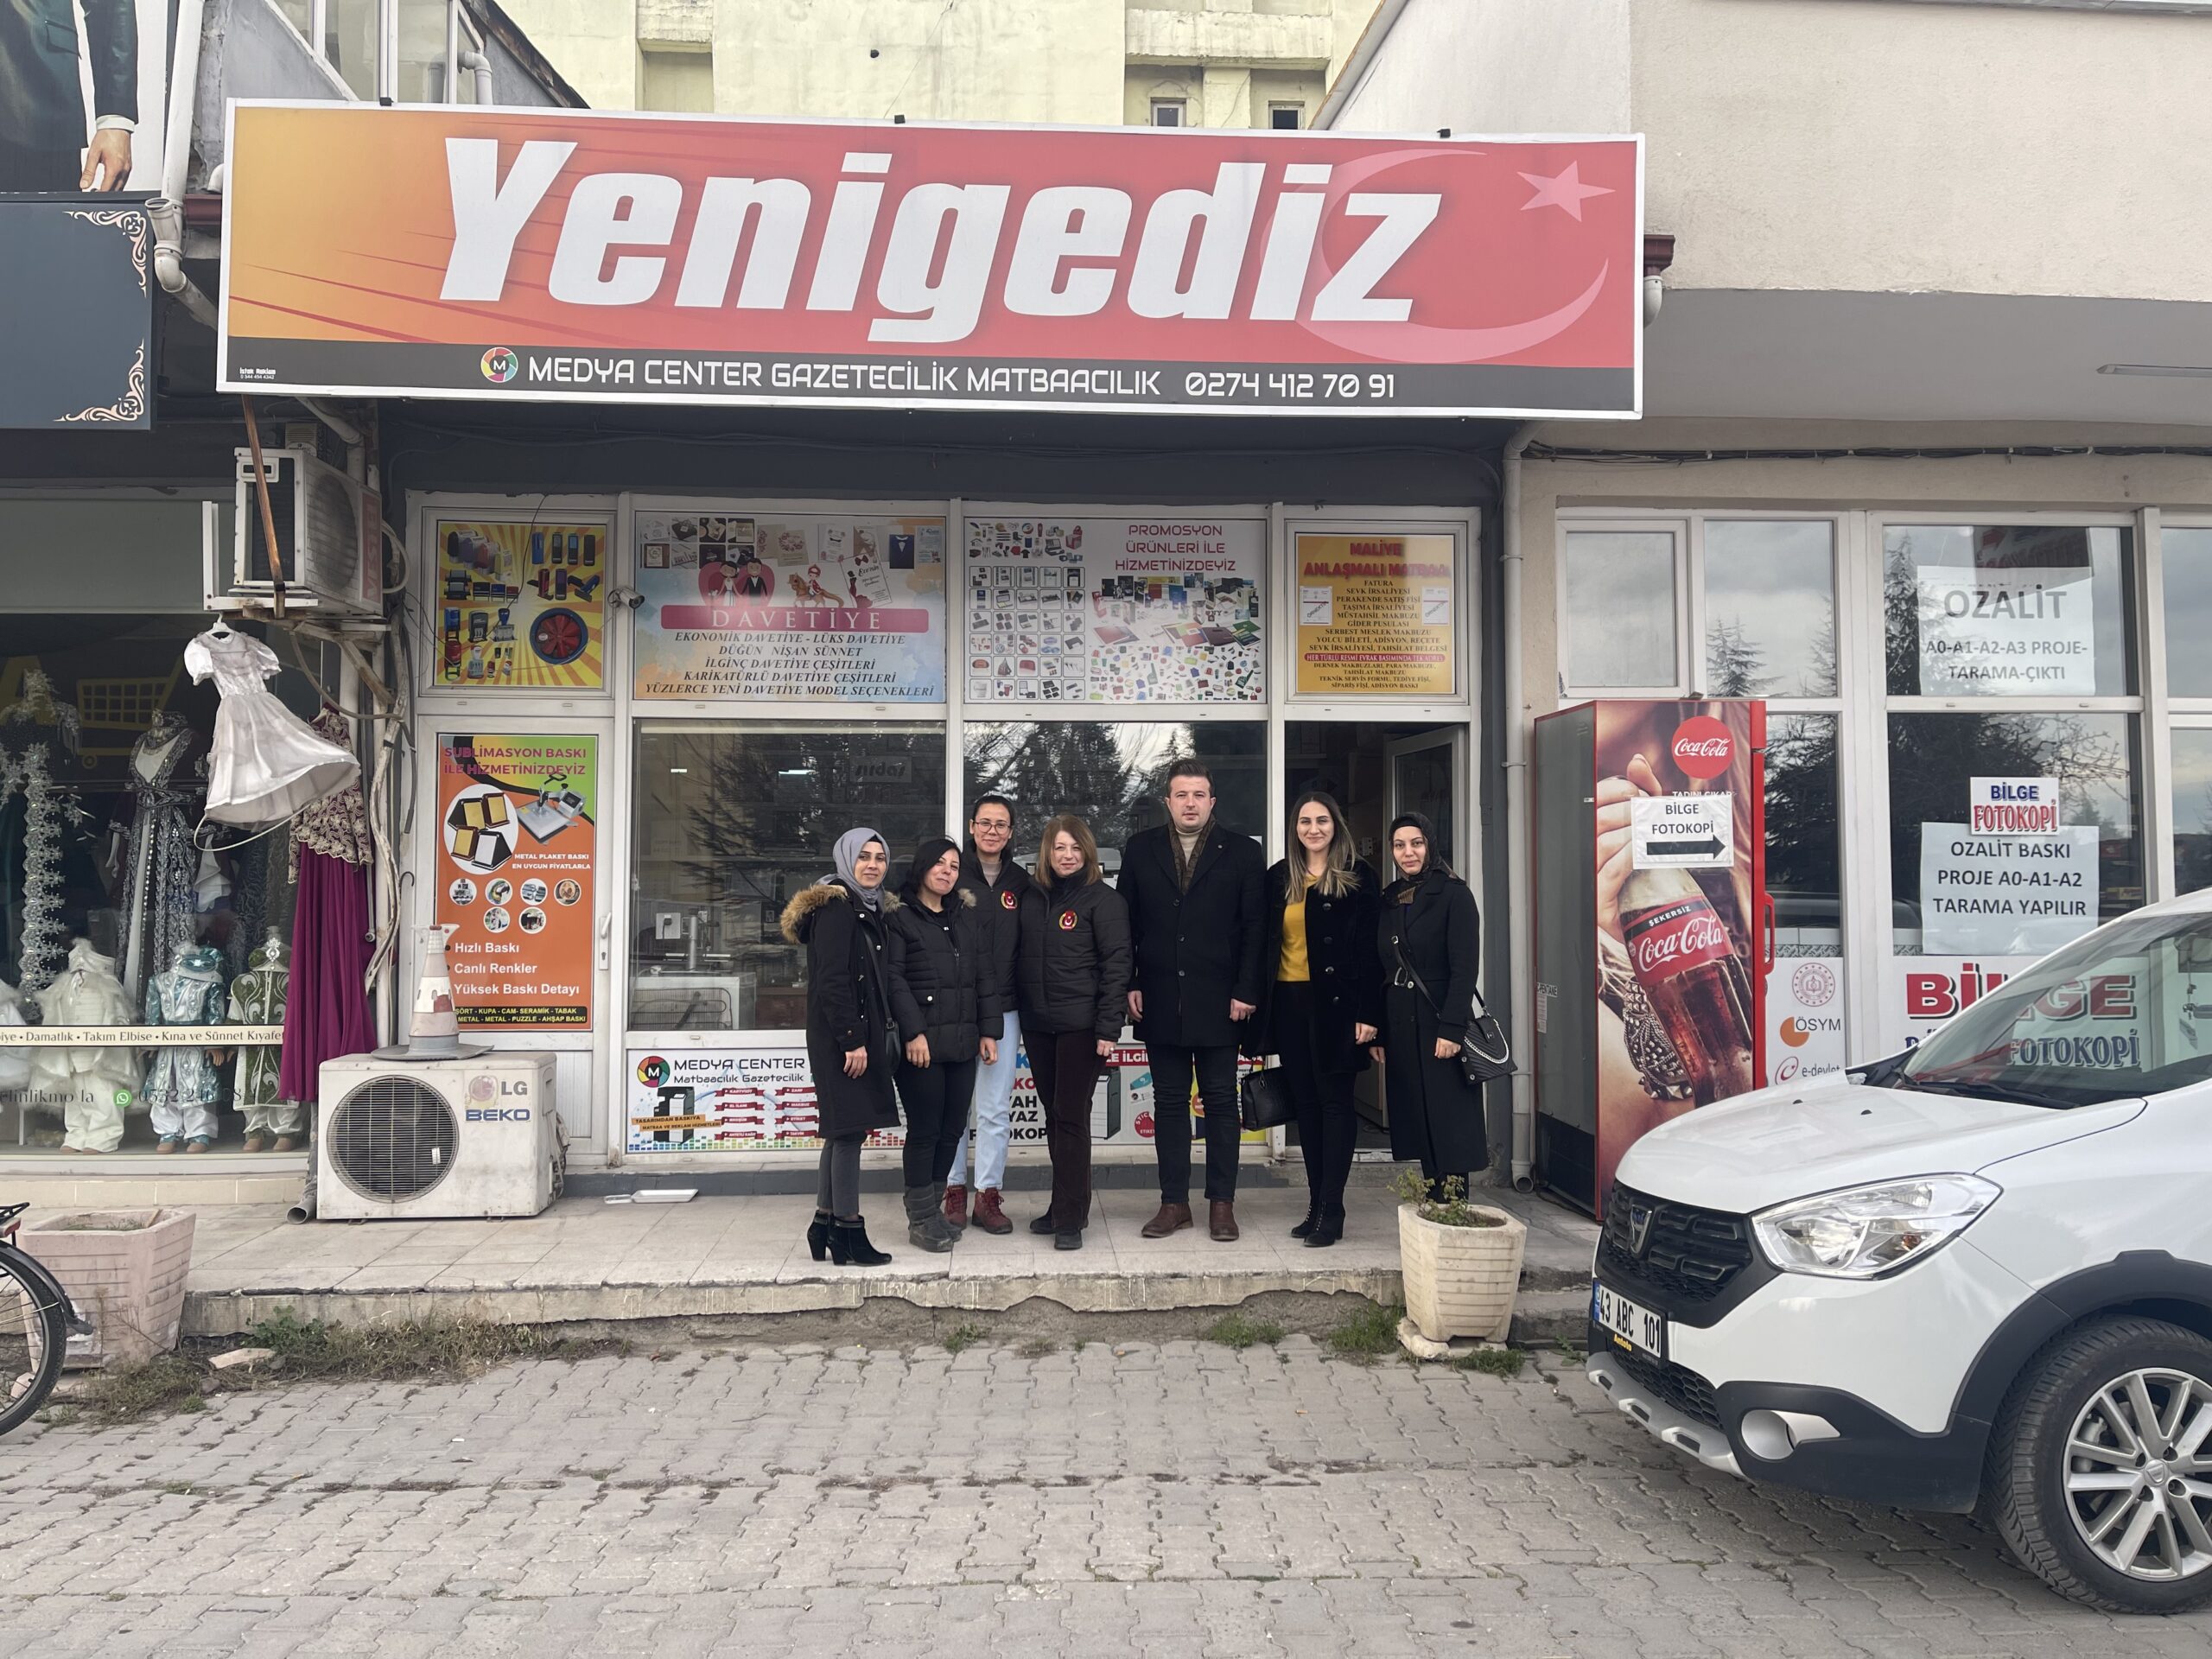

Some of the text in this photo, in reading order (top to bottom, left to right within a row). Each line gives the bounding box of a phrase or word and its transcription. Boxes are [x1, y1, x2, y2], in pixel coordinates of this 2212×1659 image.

[439, 136, 1444, 345] Yenigediz
[528, 356, 1395, 398] MEDYA CENTER GAZETECİLİK MATBAACILIK 0274 412 70 91
[1128, 524, 1223, 536] PROMOSYON
[1126, 539, 1225, 554] ÜRÜNLERİ İLE
[1115, 557, 1236, 571] HİZMETİNİZDEYİZ
[1944, 584, 2067, 620] OZALİT
[711, 607, 880, 630] DAVETİYE
[675, 631, 906, 645] EKONOMİK DAVETİYE LÜKS DAVETİYE
[718, 645, 863, 658] DÜĞÜN NİŞAN SÜNNET
[1925, 640, 2088, 655] A0-A1-A2-A3 PROJE-
[705, 656, 876, 671] İLGİNÇ DAVETİYE ÇEŞİTLERİ
[683, 669, 897, 684] KARİKATÜRLÜ DAVETİYE ÇEŞİTLERİ
[1948, 665, 2066, 683] TARAMA-ÇIKTI
[646, 682, 935, 697] YÜZLERCE YENİ DAVETİYE MODEL SEÇENEKLERİ
[443, 745, 587, 758] SUBLİMASYON BASKI
[1674, 737, 1732, 758] Coca-Cola
[444, 761, 586, 775] İLE HİZMETİNİZDEYİZ
[1990, 782, 2040, 801] BİLGE
[1665, 802, 1700, 815] BİLGE
[1974, 799, 2057, 832] FOTOKOPİ
[1651, 820, 1714, 835] FOTOKOPİ
[1950, 839, 2071, 859] OZALİT BASKI
[1937, 869, 2083, 887] PROJE A0-A1-A2
[1933, 898, 2087, 916] TARAMA YAPILIR
[1649, 905, 1692, 927] ŞEKERSİZ
[454, 942, 520, 953] Hızlı Baskı
[1638, 914, 1724, 973] Coca-Cola
[454, 963, 537, 974] Canlı Renkler
[454, 983, 580, 997] Yüksek Baskı Detayı
[1796, 1016, 1840, 1032] ÖSYM
[26, 1031, 73, 1041] Damatlık
[82, 1032, 116, 1041] Takım
[119, 1031, 153, 1041] Elbise
[162, 1032, 186, 1041] Kına
[205, 1031, 244, 1040] Sünnet
[247, 1031, 284, 1043] Kıyafe
[673, 1058, 805, 1071] MEDYA CENTER
[673, 1074, 804, 1084] Matbaacılık Gazetecilik
[500, 1080, 528, 1096] LG
[465, 1109, 531, 1122] BEKO
[1599, 1289, 1611, 1324] 43
[1616, 1298, 1635, 1338] ABC
[1643, 1313, 1661, 1354] 101
